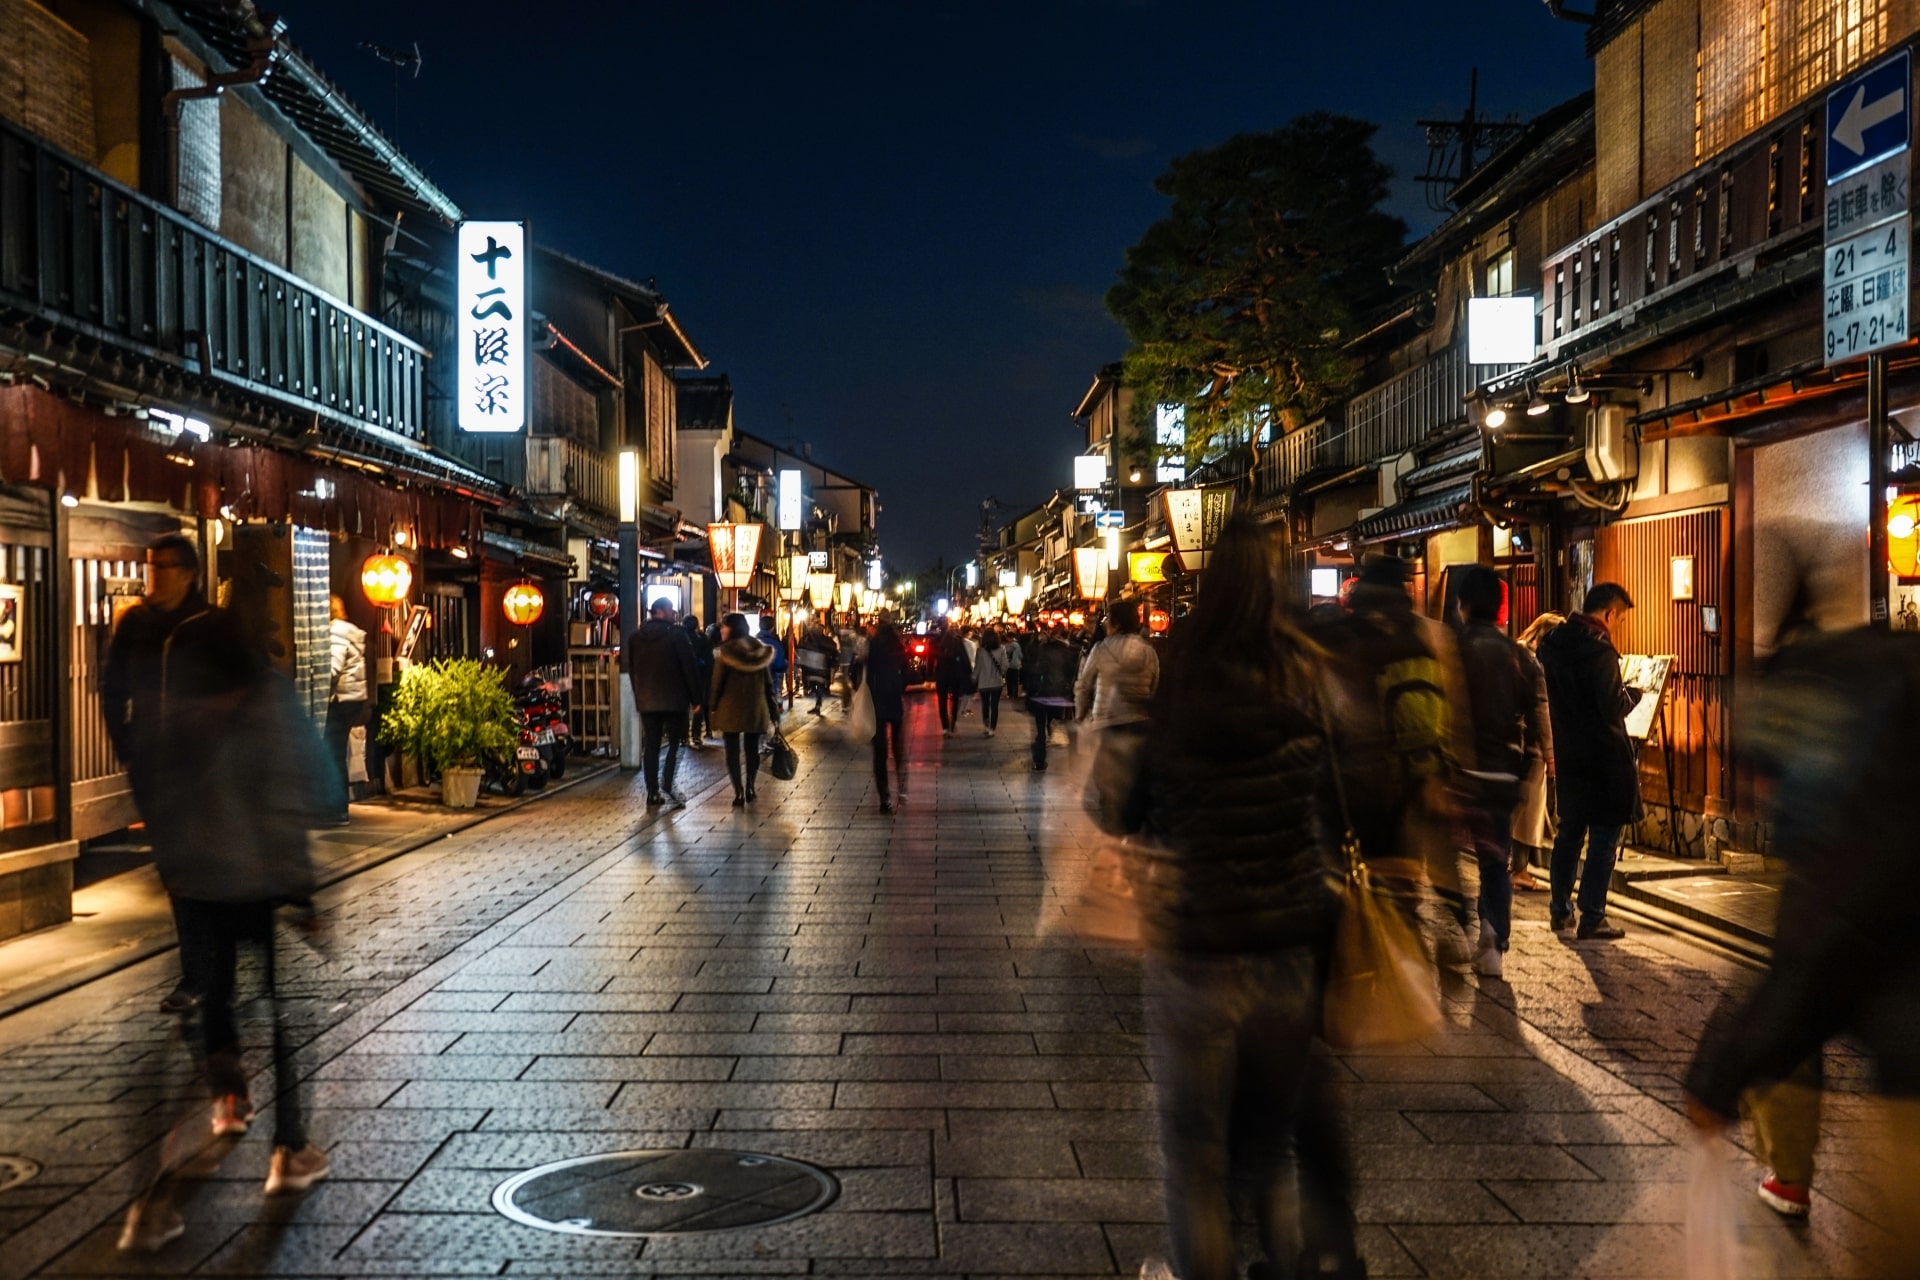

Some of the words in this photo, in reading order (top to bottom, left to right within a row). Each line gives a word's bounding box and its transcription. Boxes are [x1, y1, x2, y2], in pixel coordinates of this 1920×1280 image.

[1827, 172, 1907, 231] 自転車を除く
